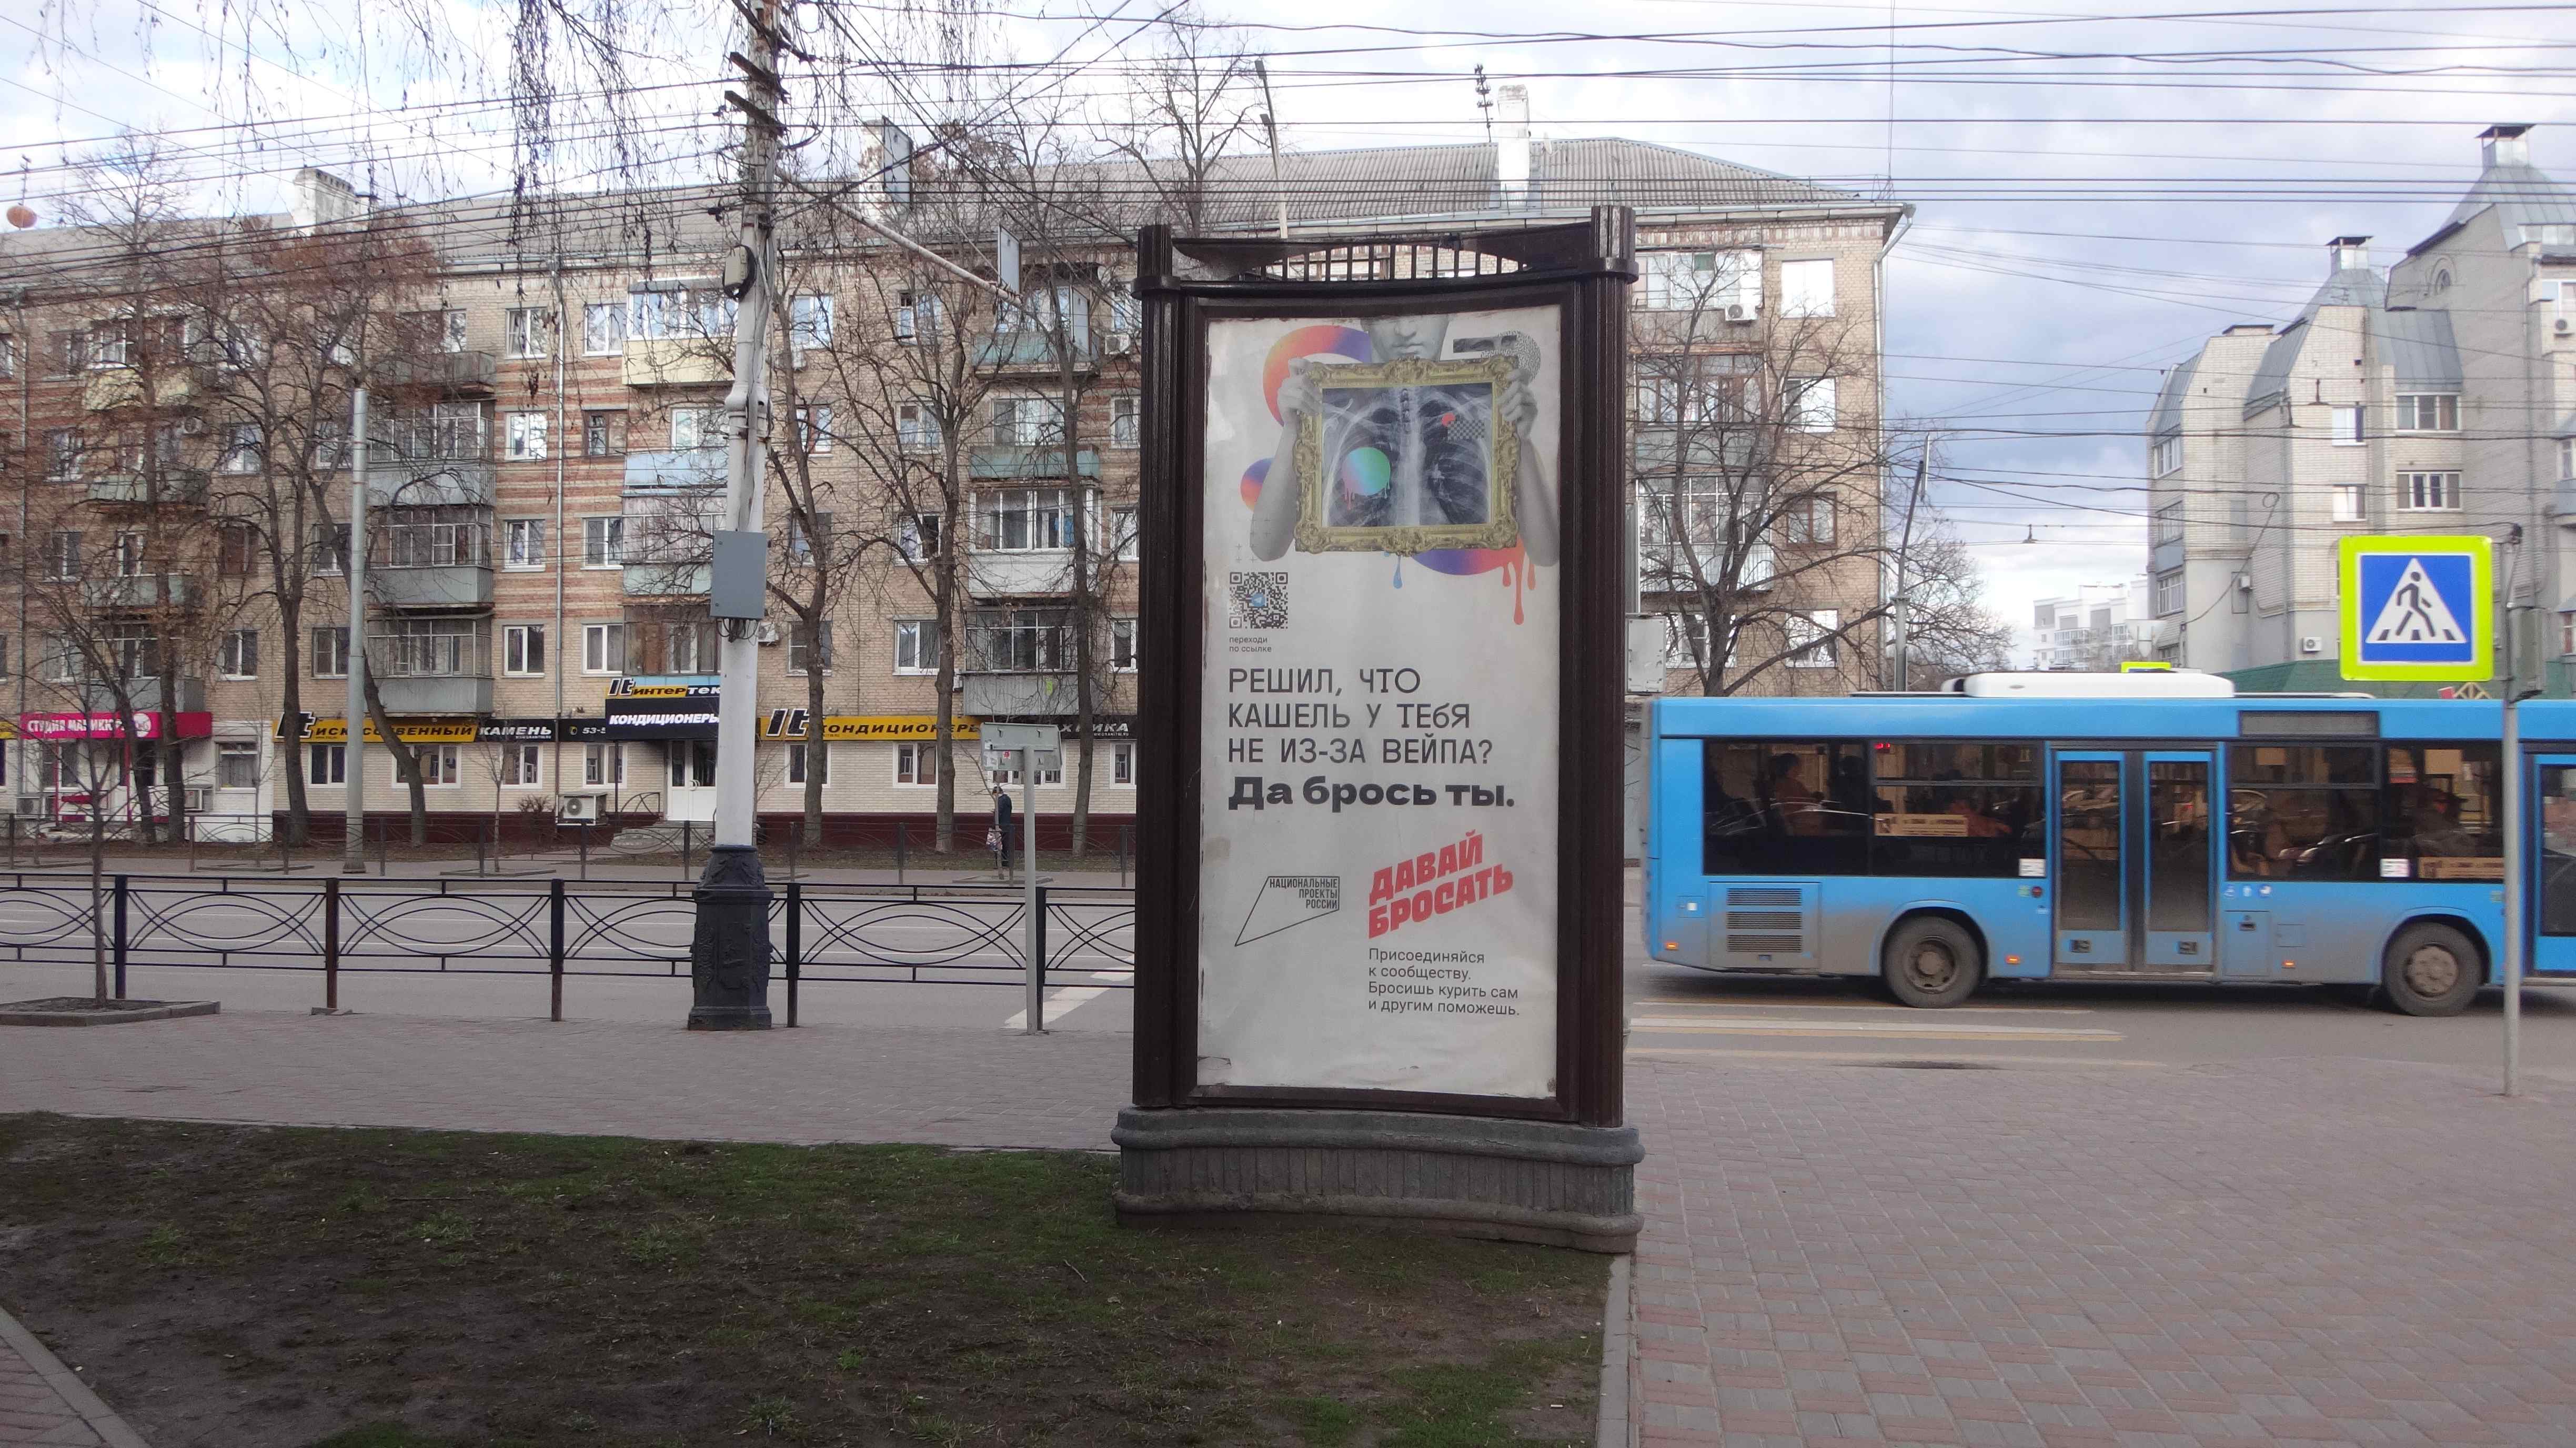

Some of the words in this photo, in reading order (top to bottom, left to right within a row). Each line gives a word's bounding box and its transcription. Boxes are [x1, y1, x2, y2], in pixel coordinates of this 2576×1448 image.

[1229, 668, 1342, 696] РЕШИЛ,
[1360, 668, 1421, 693] ЧТО
[1229, 703, 1351, 728] КАШЕЛЬ
[1366, 703, 1381, 728] У
[479, 726, 552, 736] КАМЕНЬ
[1229, 738, 1263, 763] НЕ
[1281, 738, 1366, 763] ИЗ-ЗА
[1383, 733, 1493, 764] ВЕЙПА?
[1229, 776, 1293, 810] Да
[1302, 776, 1437, 813] брось
[1445, 785, 1514, 807] ты.
[1369, 829, 1484, 906] ДАВАЙ
[1270, 878, 1337, 889] НАЦИОНАЛЬНЫЕ
[1299, 889, 1337, 898] ПРОЕКТЫ
[1368, 864, 1513, 939] БРОСАТЬ
[1306, 899, 1337, 909] РОССИИ
[1369, 948, 1484, 964] Присоединяйся
[1369, 968, 1376, 977] к
[1381, 967, 1471, 981] сообществу.
[1369, 982, 1434, 995] Бросишь
[1439, 987, 1486, 999] курить
[1491, 989, 1518, 999] сам
[1369, 1001, 1376, 1010] и
[1381, 1001, 1433, 1013] другим
[1437, 1003, 1520, 1015] поможешь.
